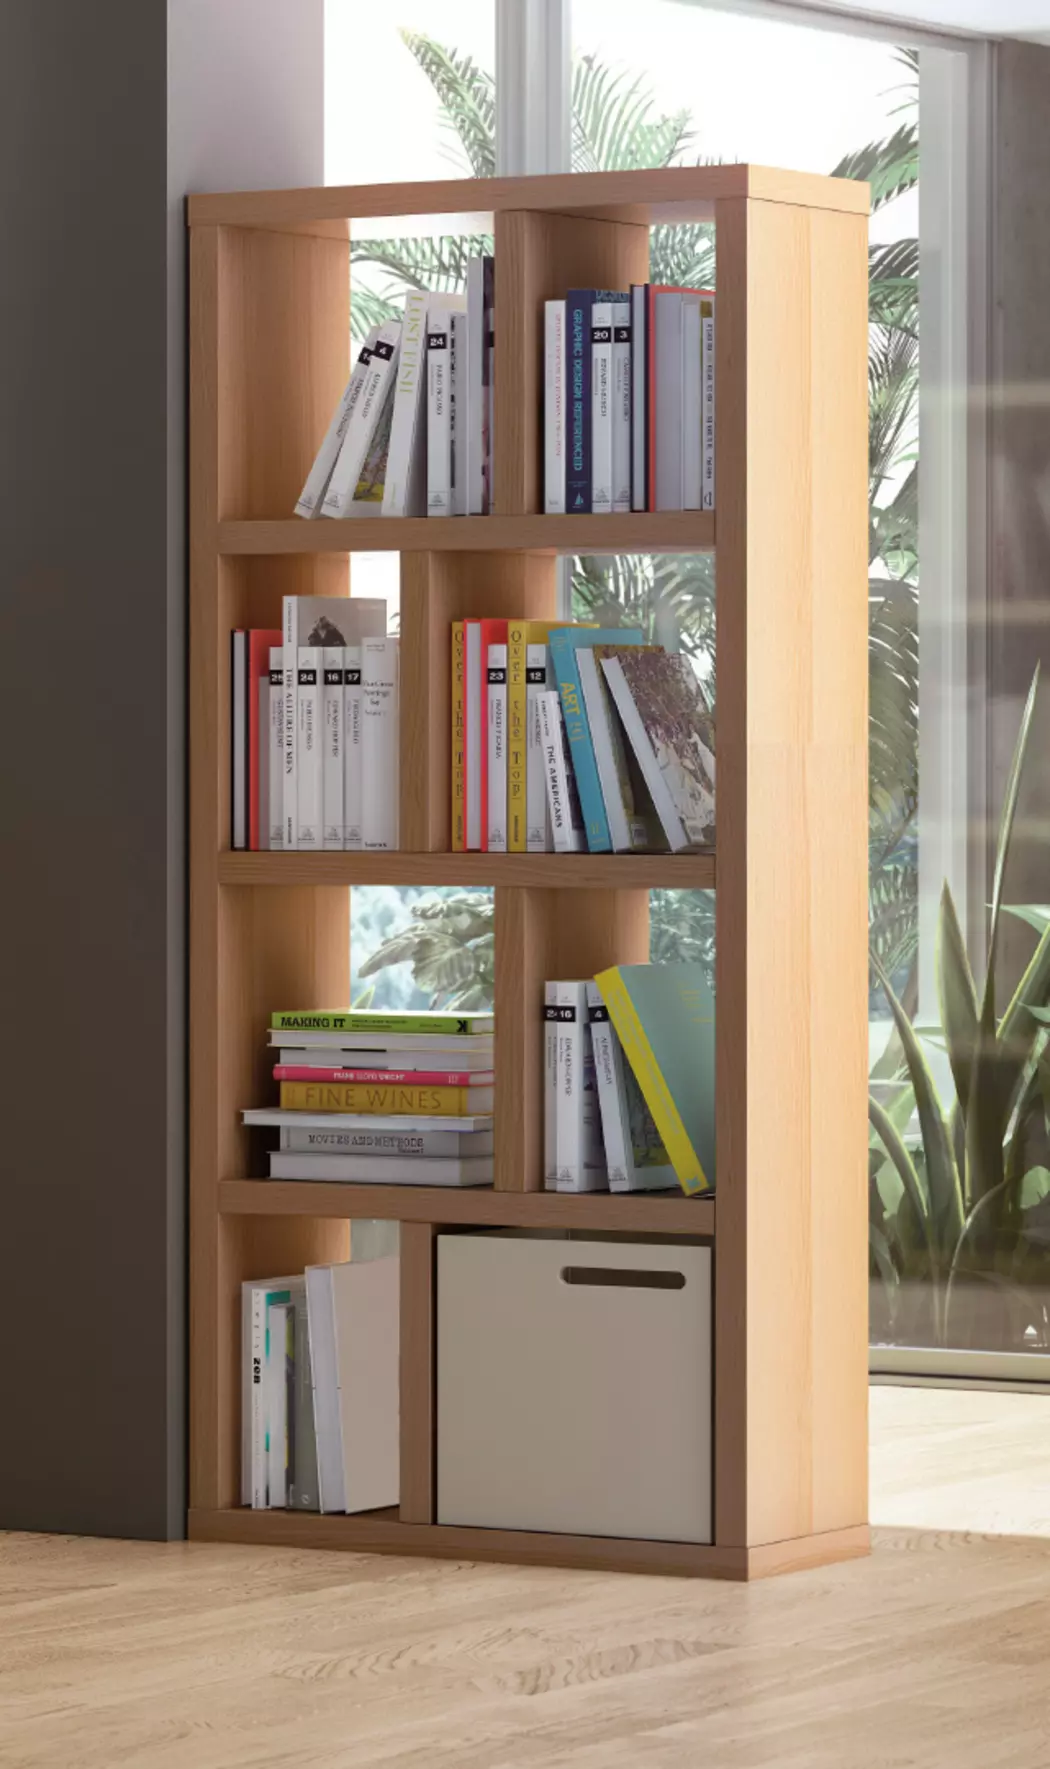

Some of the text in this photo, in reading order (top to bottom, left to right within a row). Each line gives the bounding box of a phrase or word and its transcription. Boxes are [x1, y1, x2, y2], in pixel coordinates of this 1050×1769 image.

[399, 295, 425, 394] LOST FISH
[430, 336, 444, 347] 24
[572, 308, 583, 356] GRAPHIC
[593, 330, 608, 340] 20
[572, 359, 583, 399] DESIGN
[572, 401, 583, 471] REFERENCED
[300, 673, 314, 682] 24
[347, 672, 360, 681] 17
[489, 672, 504, 681] 23
[560, 682, 580, 716] ART
[286, 668, 294, 775] THE ALLURE OF MEN
[511, 630, 522, 797] Over the Top
[546, 745, 563, 829] THE AMERICANS
[280, 1016, 329, 1028] MAKING
[333, 1018, 346, 1028] IT
[305, 1087, 442, 1110] FINE WINES
[308, 1133, 350, 1146] MOVIES
[351, 1135, 373, 1146] AND
